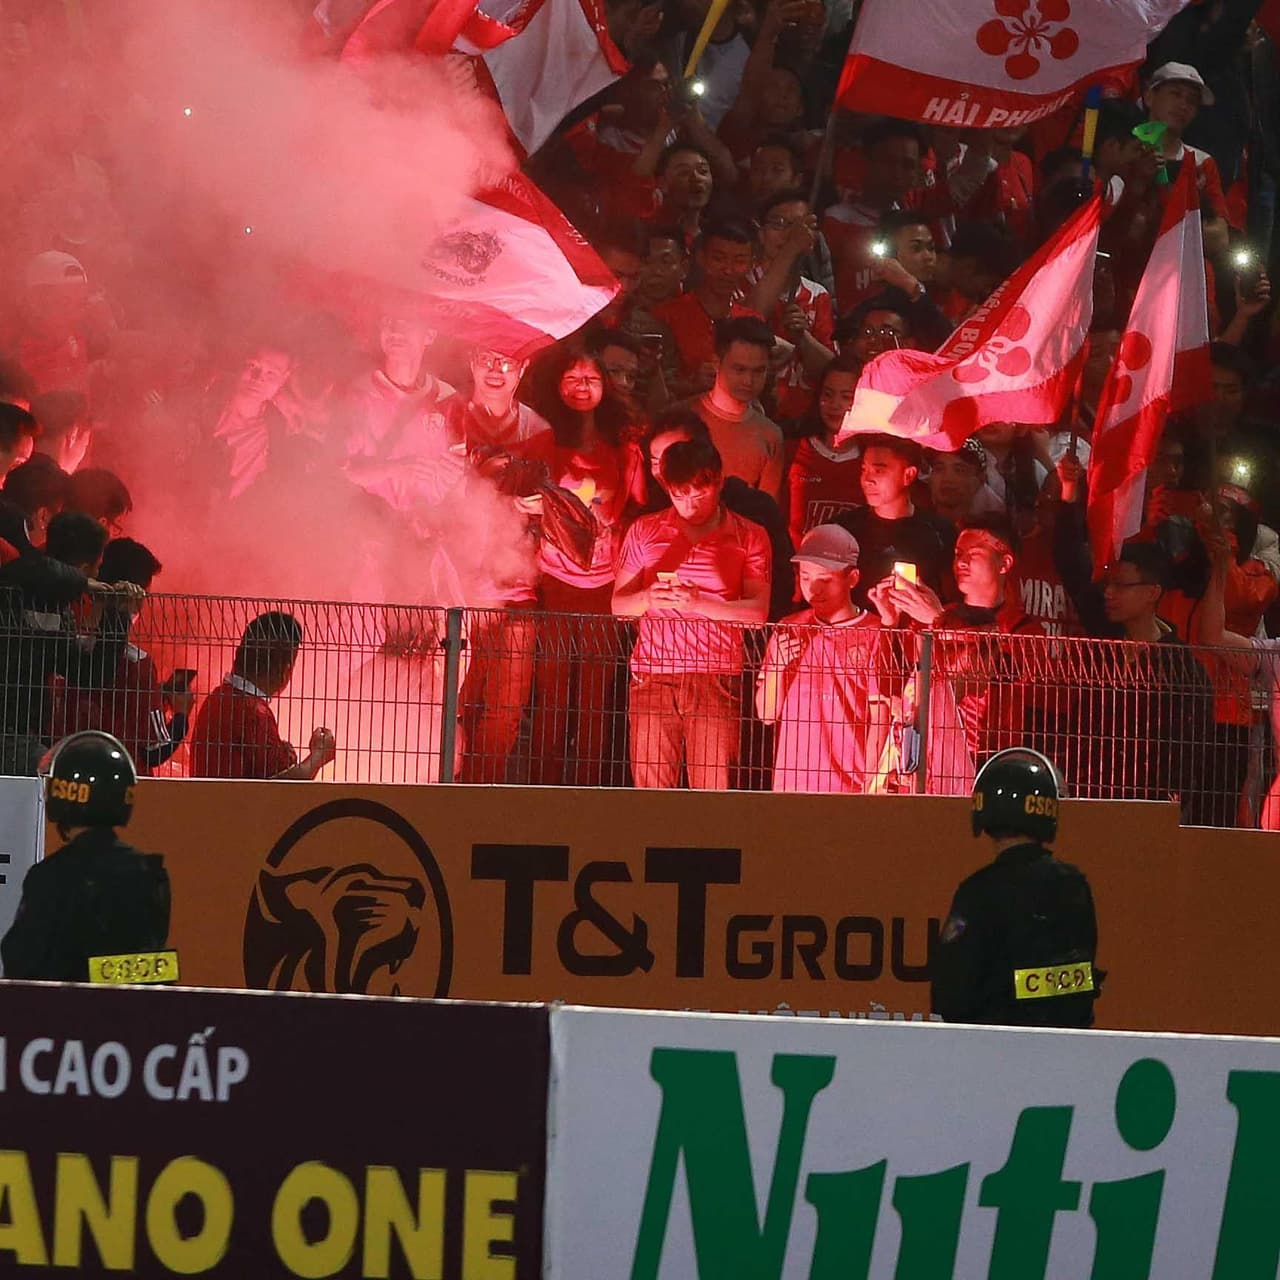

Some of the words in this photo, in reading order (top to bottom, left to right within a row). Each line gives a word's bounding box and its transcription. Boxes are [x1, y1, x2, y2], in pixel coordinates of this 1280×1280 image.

[922, 91, 981, 129] HẢI
[470, 843, 740, 979] T&T
[725, 914, 938, 982] GROU
[19, 1036, 132, 1100] CAO
[142, 1026, 251, 1102] CẤP
[271, 1159, 519, 1280] ONE
[630, 1046, 1280, 1280] Nuti
